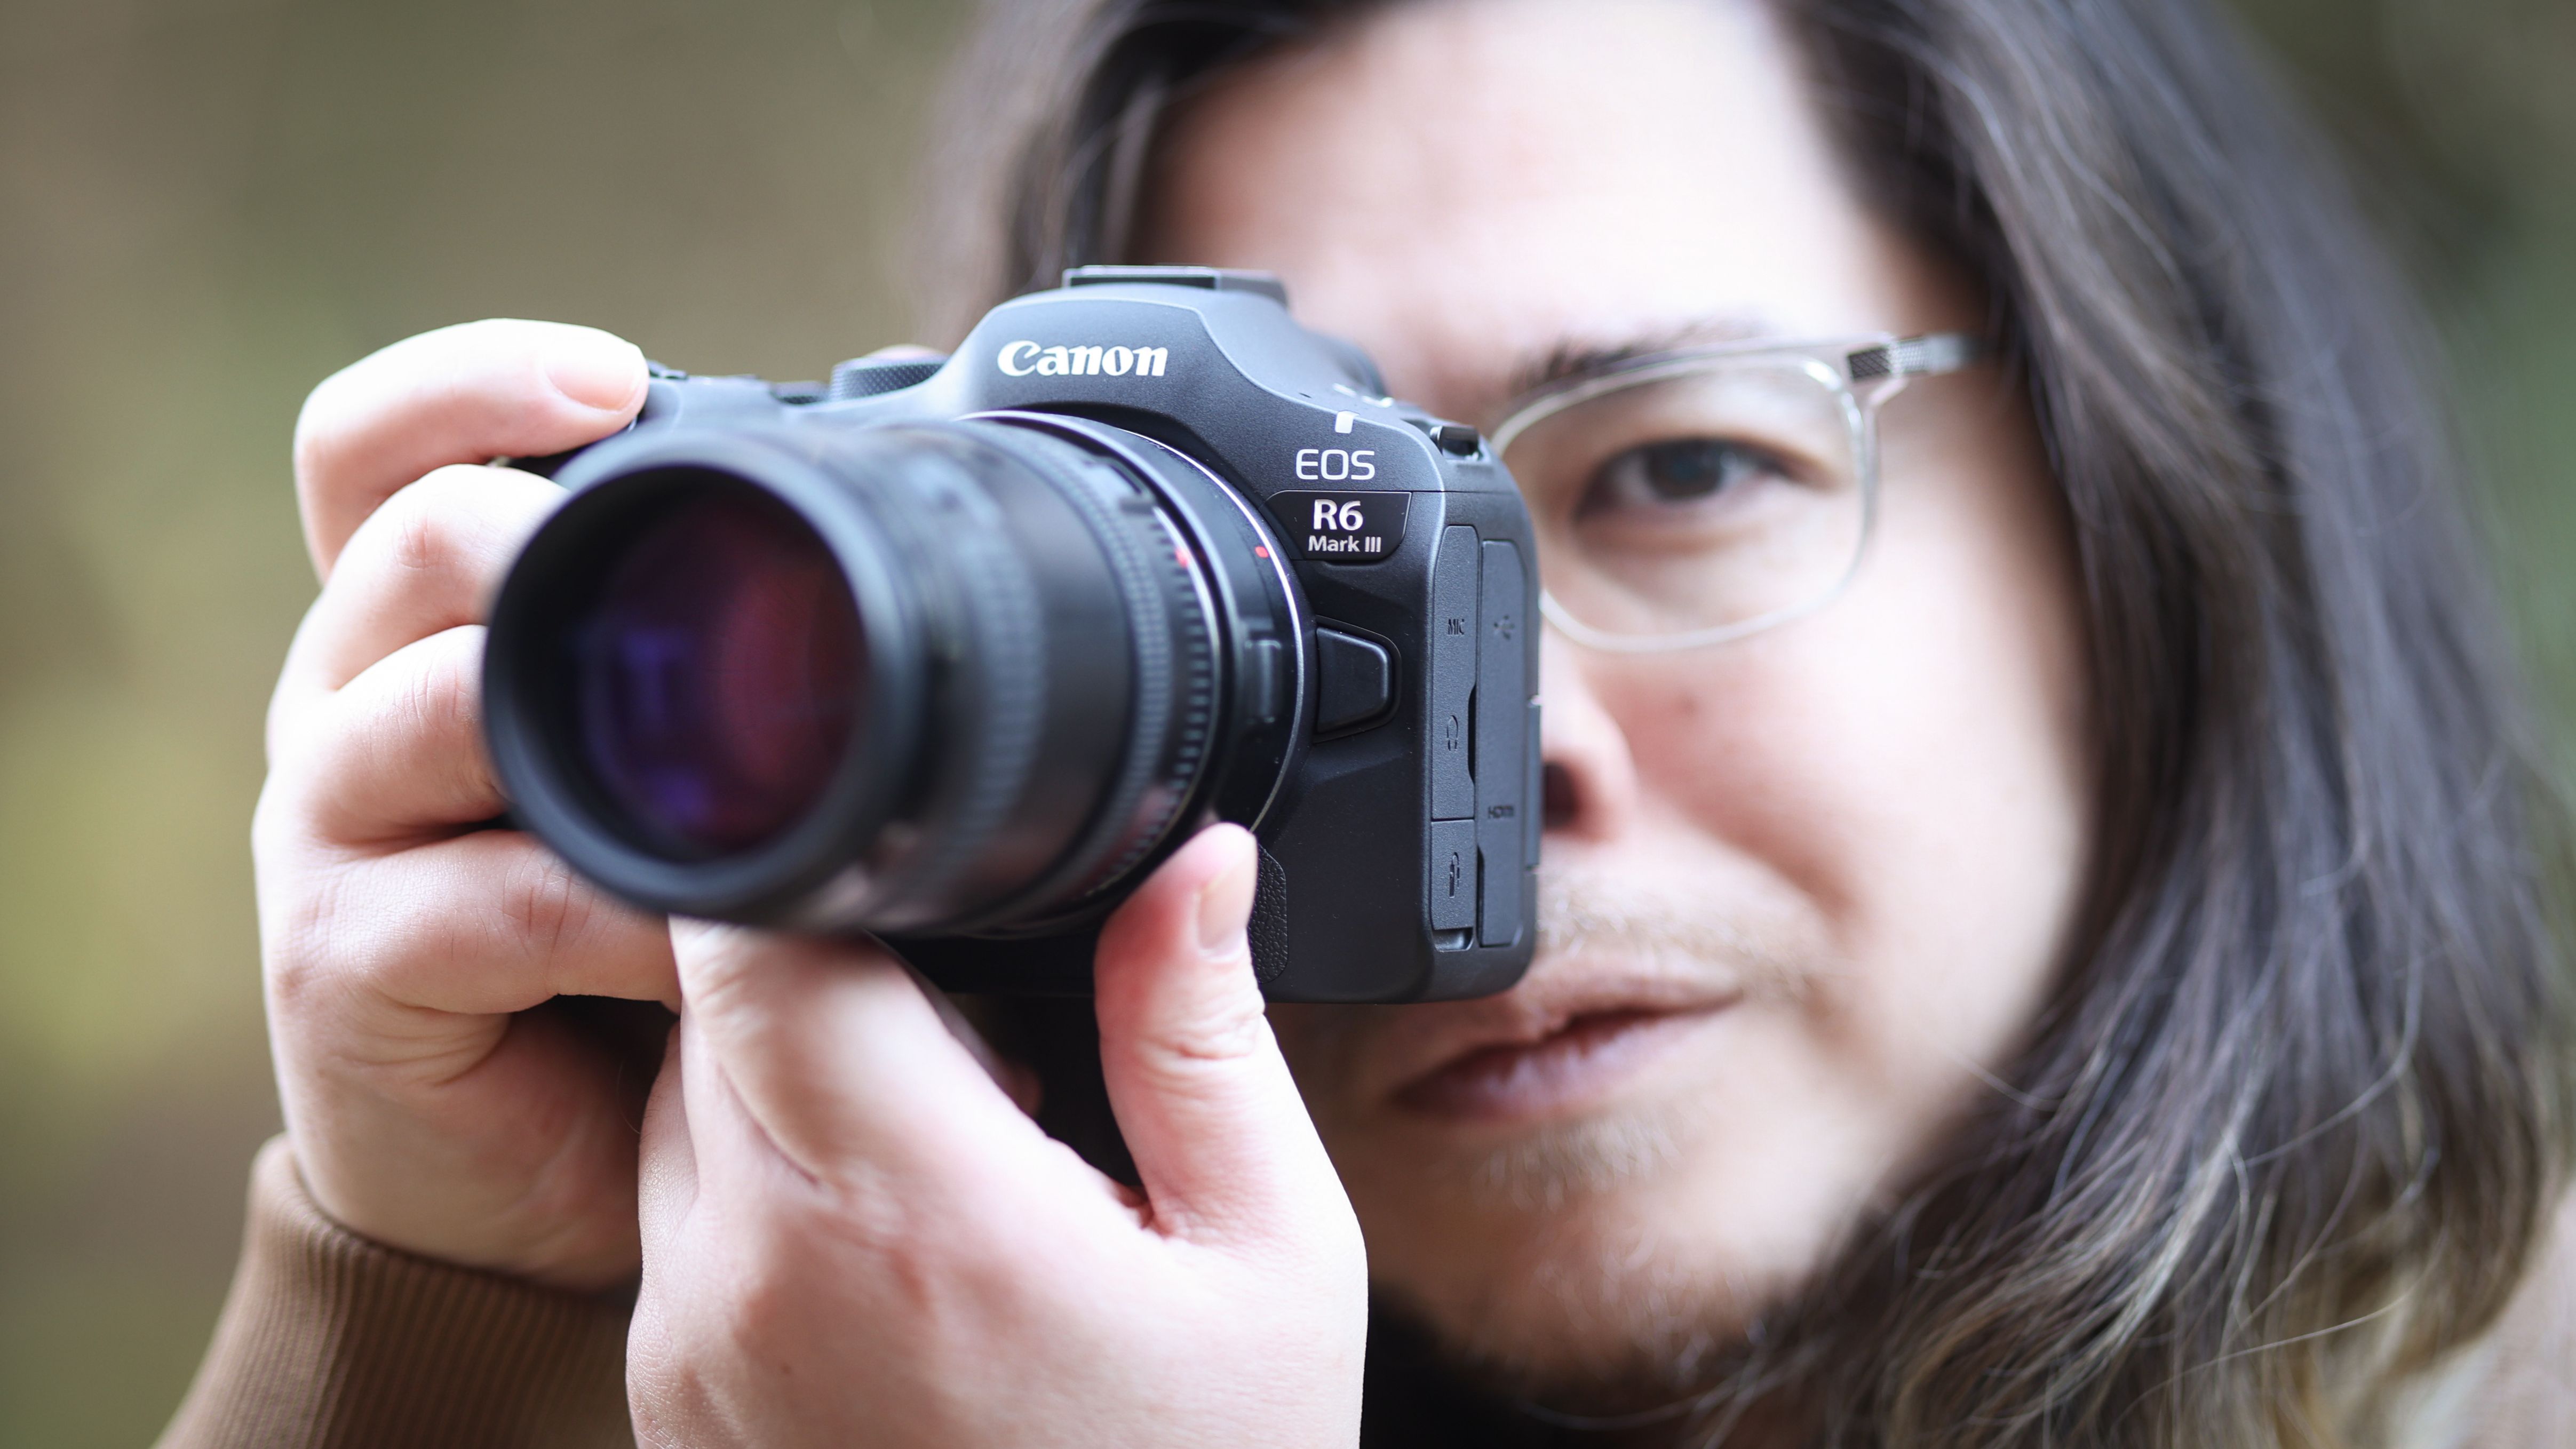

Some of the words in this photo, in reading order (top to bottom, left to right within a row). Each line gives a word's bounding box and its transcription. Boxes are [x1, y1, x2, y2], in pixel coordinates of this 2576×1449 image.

[997, 340, 1168, 377] Canon
[1295, 449, 1375, 480] EOS
[1314, 499, 1364, 531] R6
[1308, 535, 1361, 552] Mark
[1365, 536, 1381, 552] III
[1448, 618, 1465, 635] MIC
